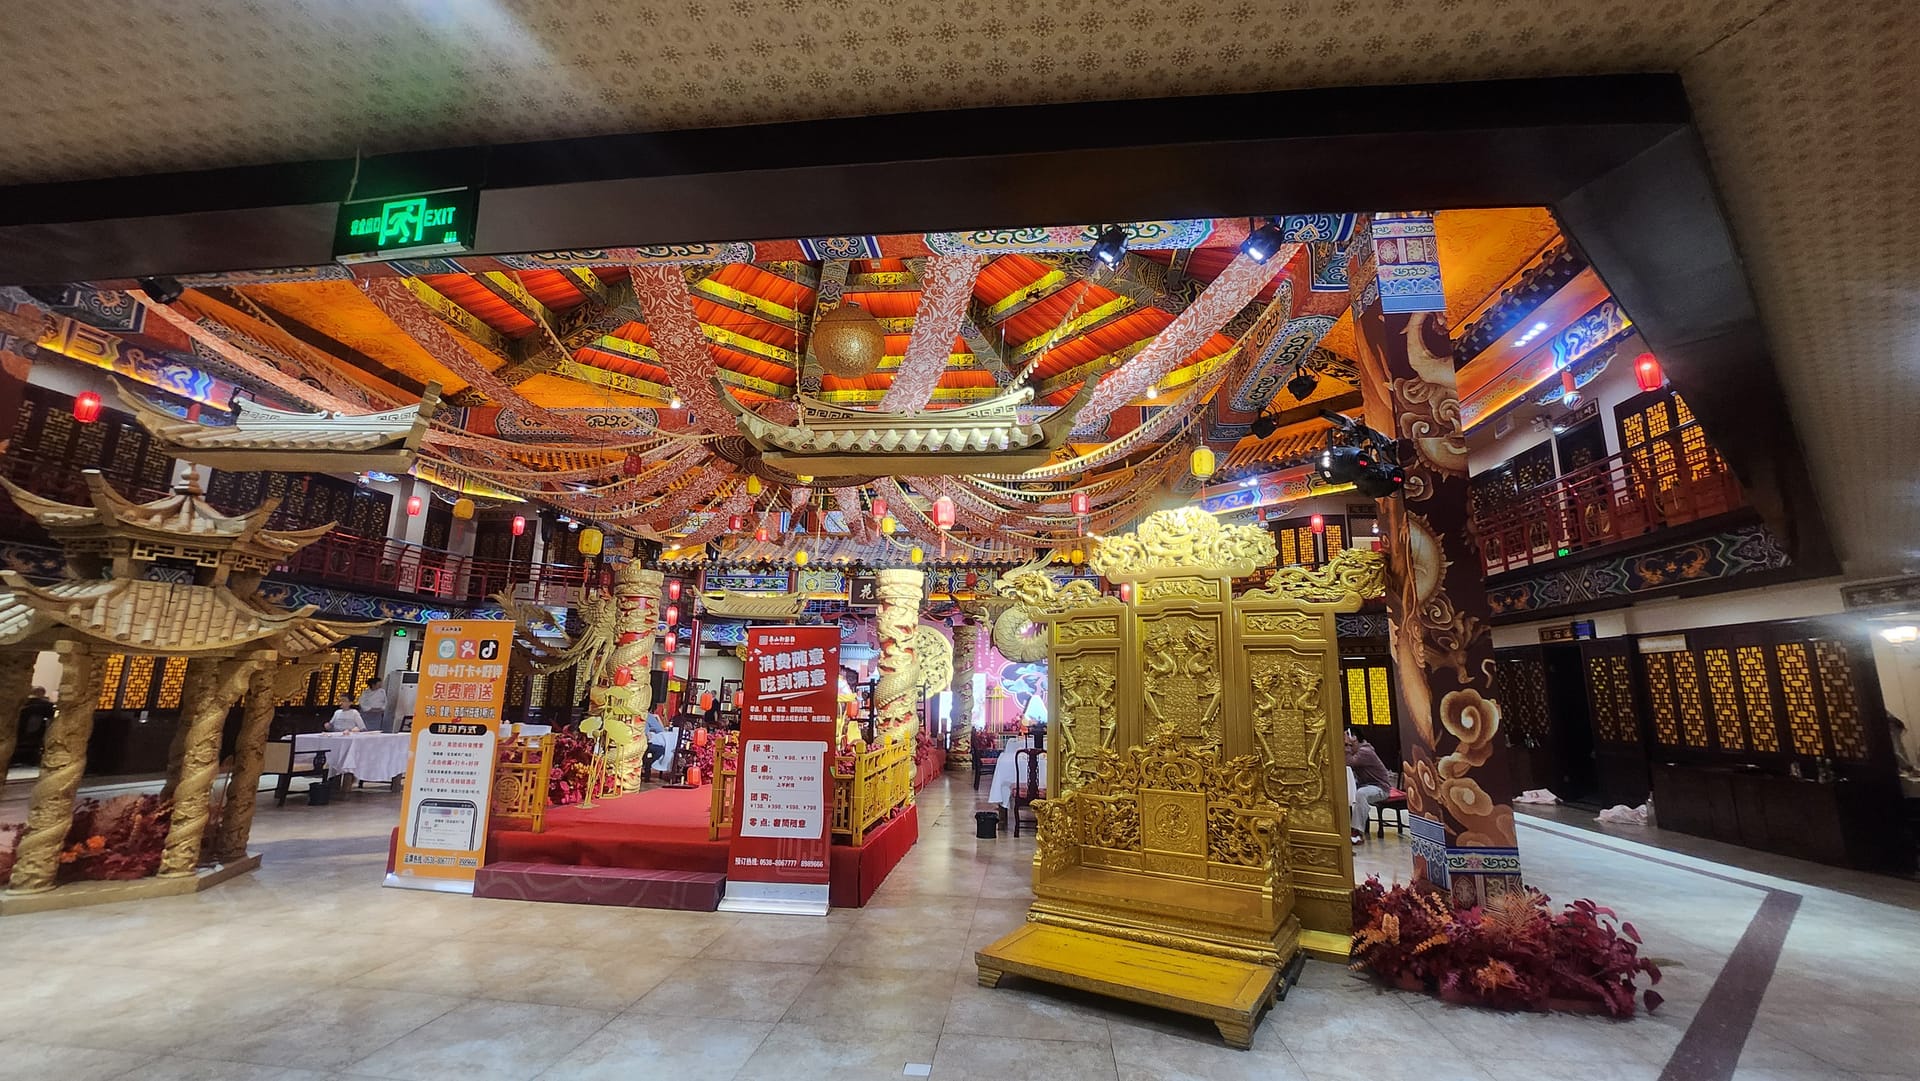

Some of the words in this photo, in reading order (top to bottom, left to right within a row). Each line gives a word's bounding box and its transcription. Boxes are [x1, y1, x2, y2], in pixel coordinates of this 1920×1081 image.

[423, 207, 456, 227] EXIT
[758, 648, 825, 673] 消费随意
[759, 669, 827, 693] 吃到满意
[432, 682, 494, 702] 免费赠送
[437, 724, 477, 735] 活动方式
